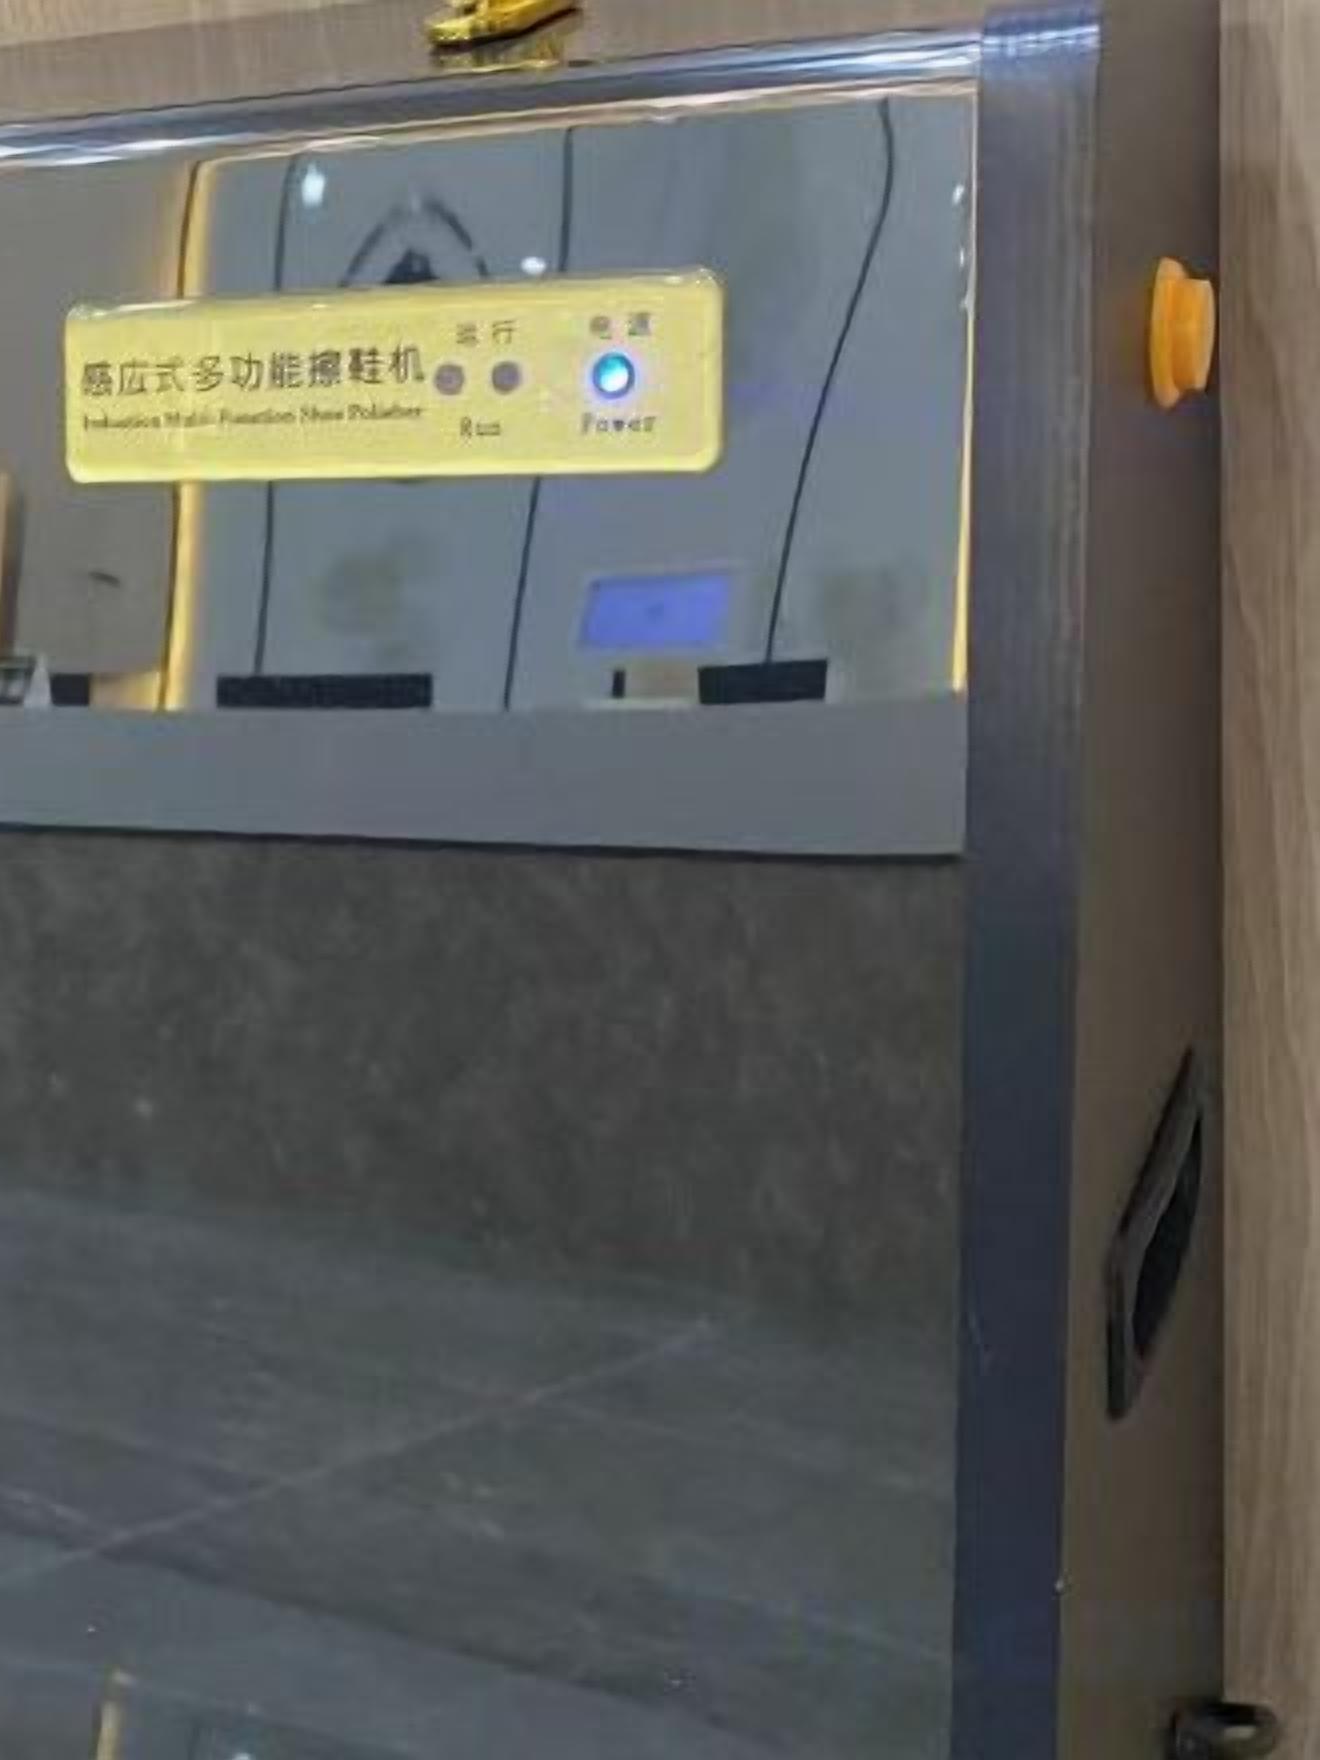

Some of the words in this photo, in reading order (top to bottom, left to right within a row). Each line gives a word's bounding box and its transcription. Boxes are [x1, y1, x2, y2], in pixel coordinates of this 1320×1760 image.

[82, 346, 425, 396] 感应式多功能擦鞋机
